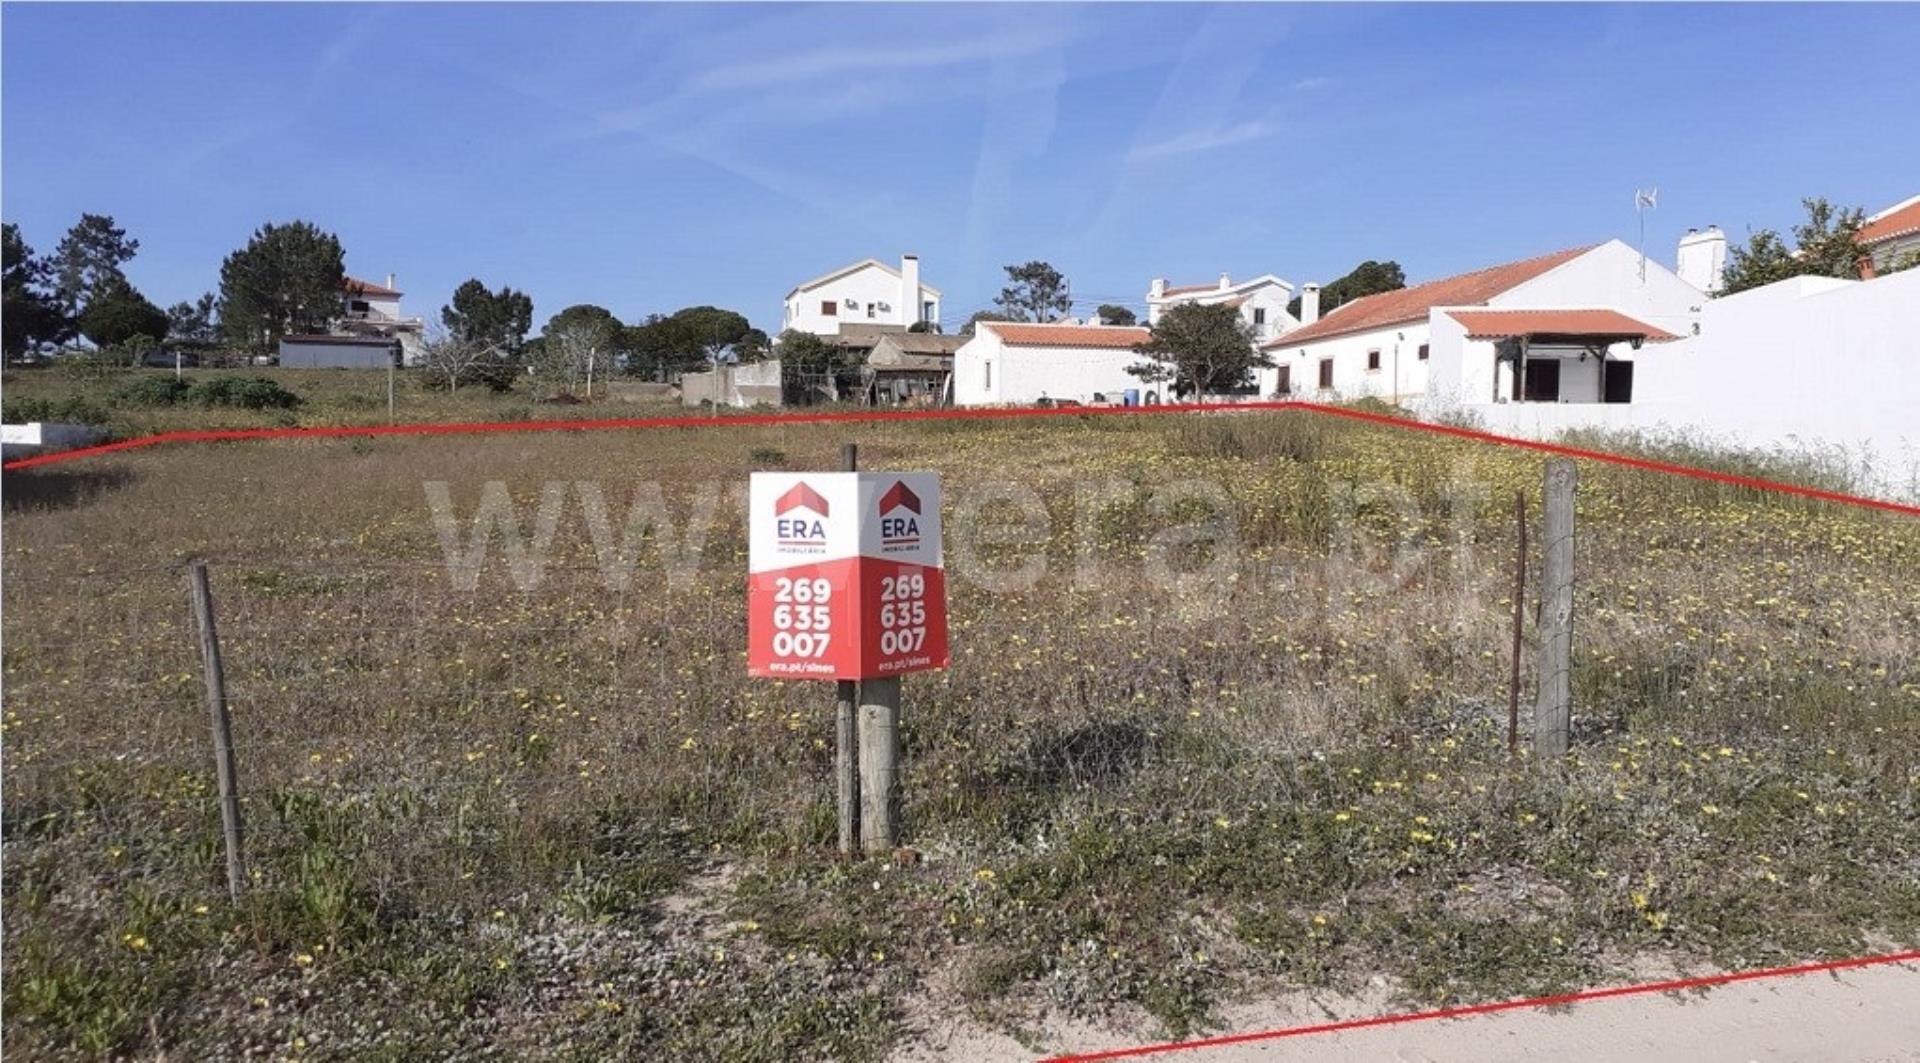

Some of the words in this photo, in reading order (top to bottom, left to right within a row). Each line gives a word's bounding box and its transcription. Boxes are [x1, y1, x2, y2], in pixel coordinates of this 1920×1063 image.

[777, 519, 826, 538] ERA
[882, 518, 920, 538] ERA
[774, 577, 832, 603] 269
[881, 574, 925, 602] 269
[773, 604, 831, 630] 635
[881, 600, 926, 628] 635
[772, 631, 831, 657] 007
[880, 627, 926, 655] 007
[769, 662, 836, 674] era.pt/sines
